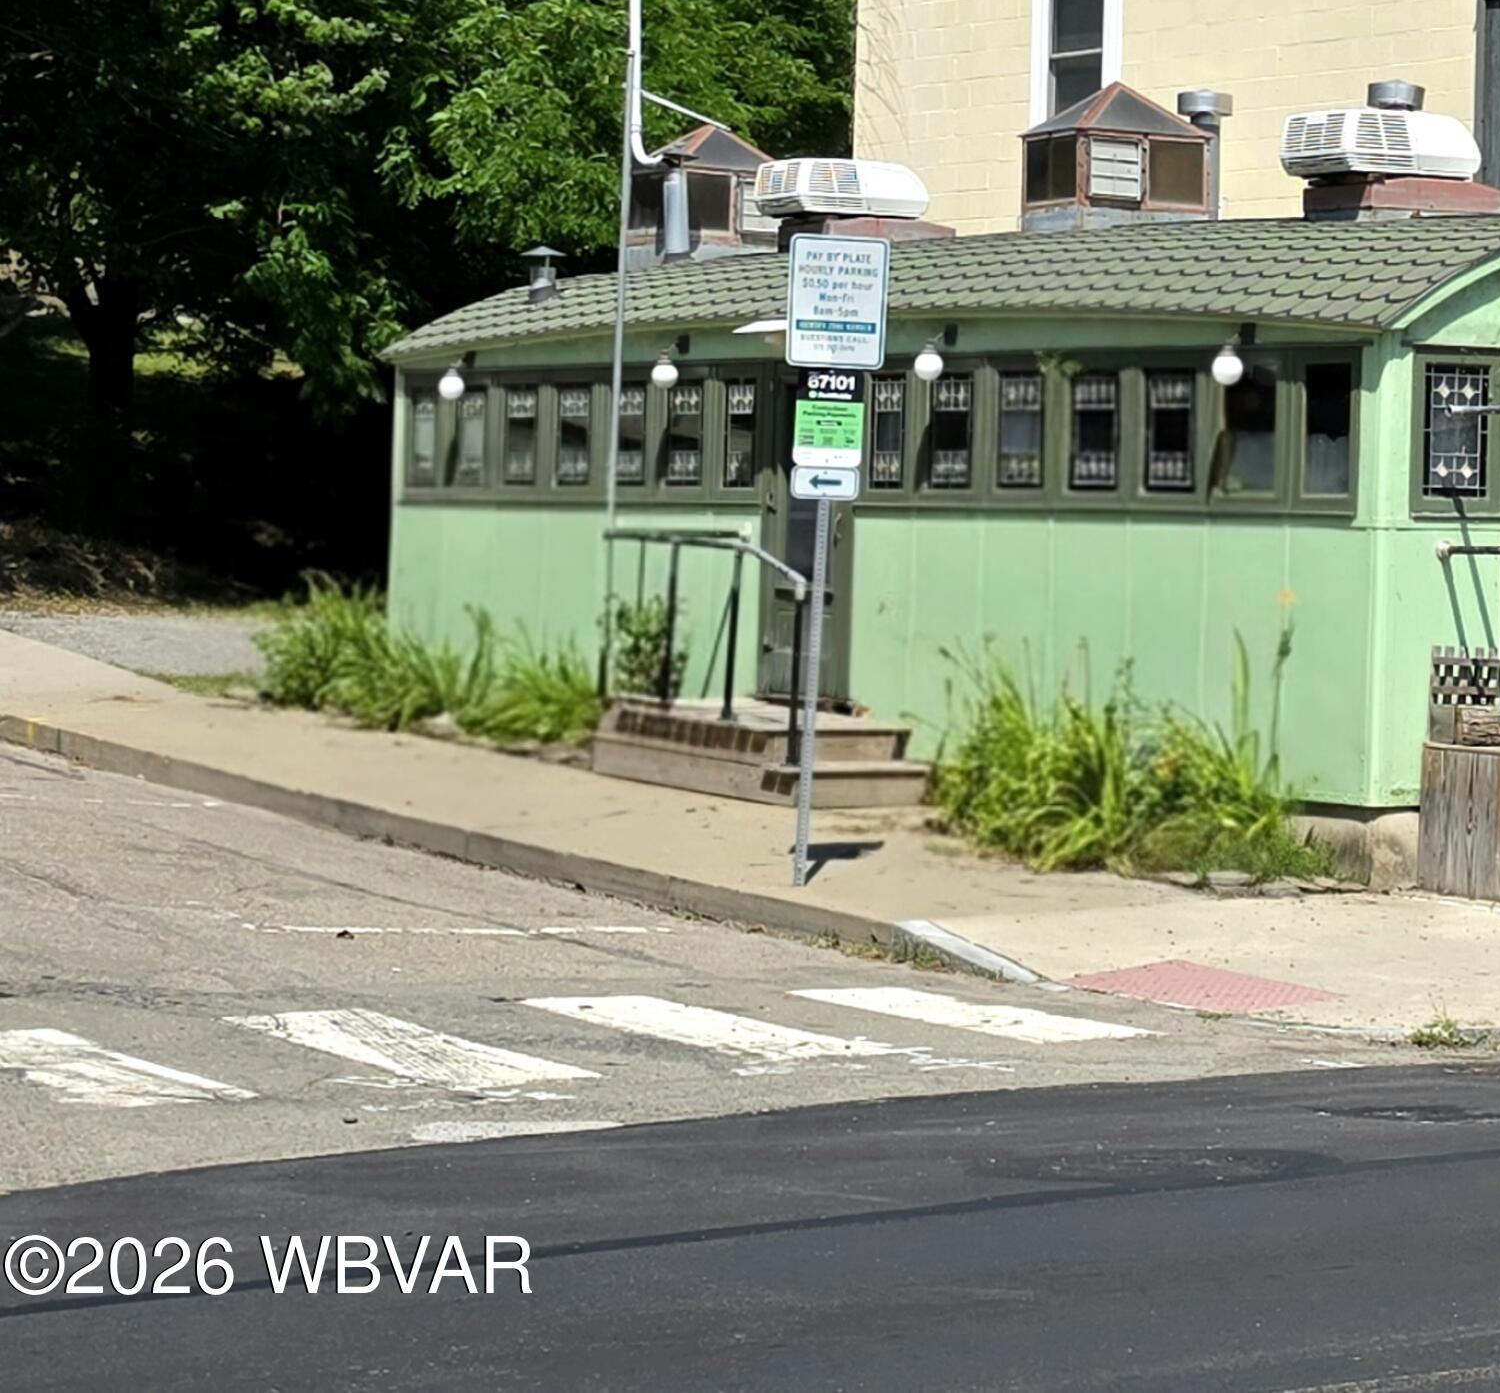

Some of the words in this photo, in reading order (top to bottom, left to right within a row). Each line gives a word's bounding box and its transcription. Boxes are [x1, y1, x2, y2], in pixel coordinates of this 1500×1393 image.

[806, 251, 823, 261] PAY
[826, 252, 841, 262] BY
[843, 253, 871, 264] PLATE
[799, 265, 834, 275] HOURLY
[838, 267, 879, 278] PARKING
[832, 281, 848, 290] per
[851, 280, 873, 290] hour
